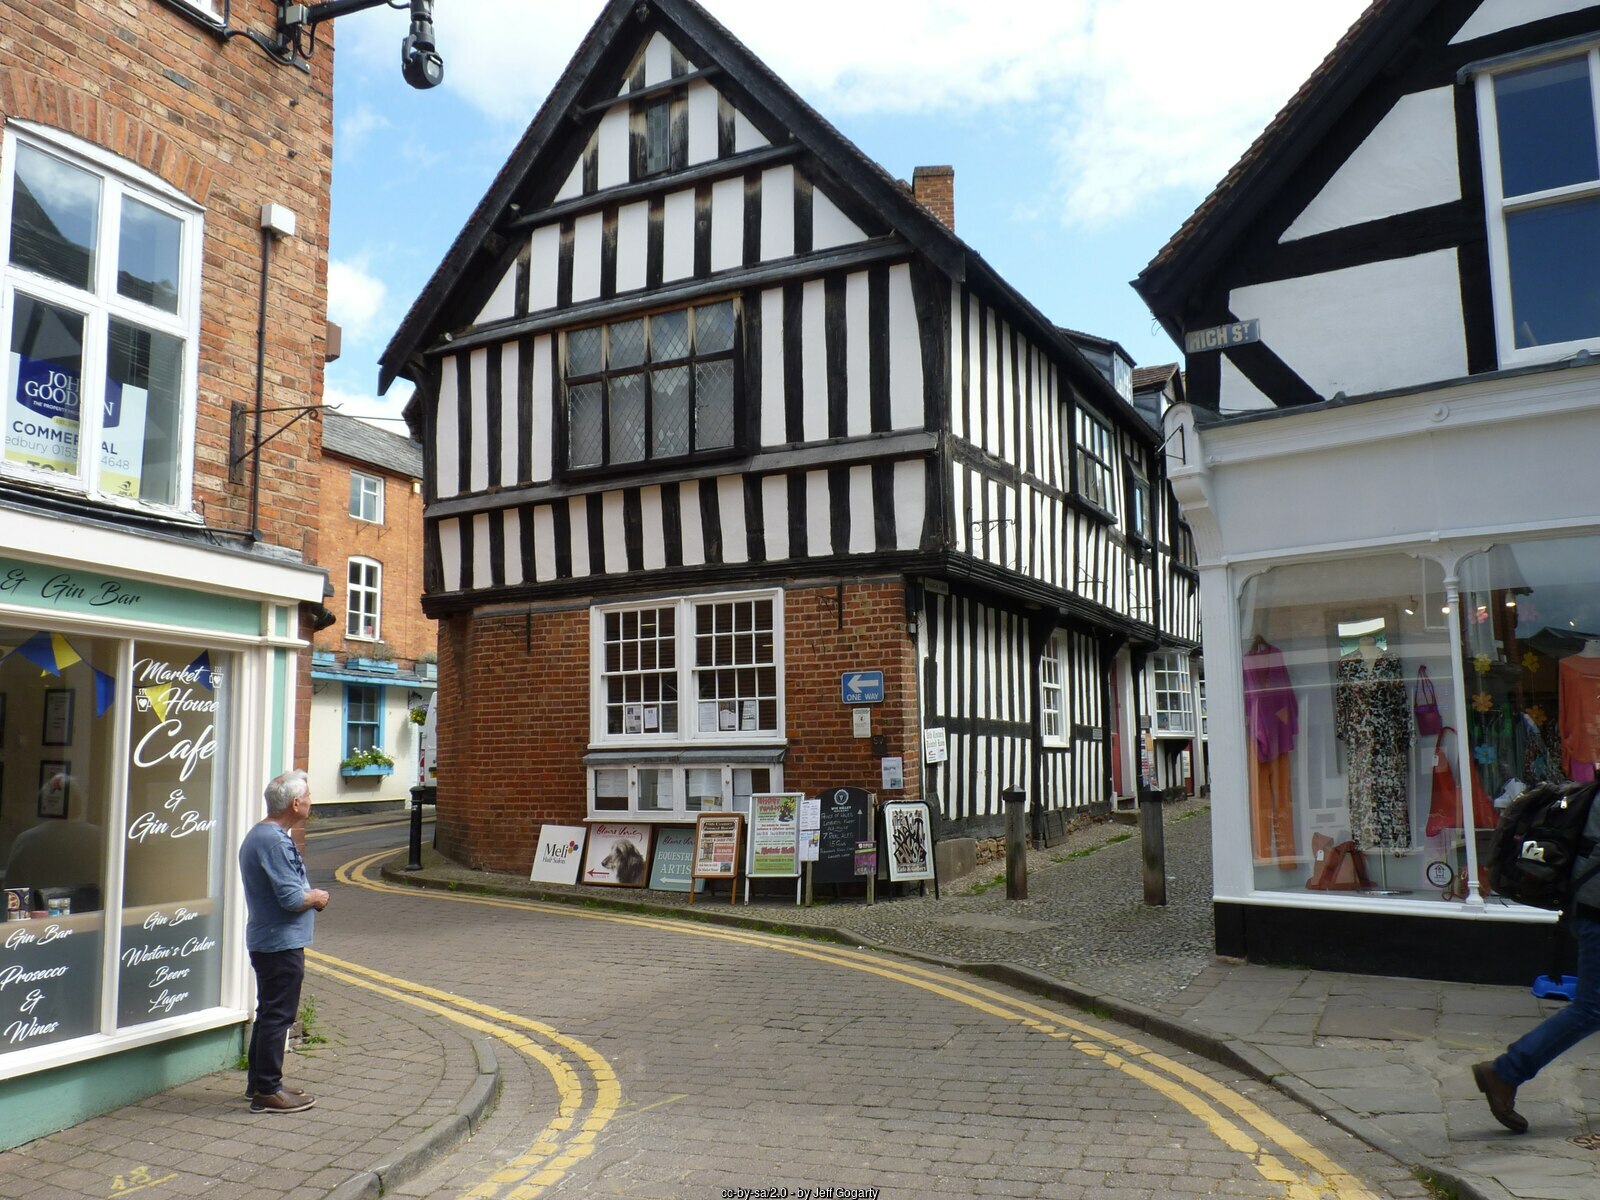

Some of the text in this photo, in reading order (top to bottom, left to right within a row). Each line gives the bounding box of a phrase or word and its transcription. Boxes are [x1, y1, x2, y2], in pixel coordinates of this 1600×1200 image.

[48, 370, 80, 393] JOH
[5, 435, 48, 455] edbury
[41, 573, 86, 604] Gin
[89, 580, 141, 606] Bar
[132, 658, 211, 684] Market
[158, 687, 219, 716] House
[846, 692, 879, 701] ONE WAY
[134, 718, 219, 782] Cafe
[128, 810, 217, 844] Gin Bar
[542, 856, 553, 864] Hair
[545, 843, 569, 859] Meli
[660, 864, 692, 875] ARTIS
[143, 908, 198, 930] Gin Bar
[5, 924, 74, 950] Gin Bar
[122, 937, 216, 968] Weston's Cider
[0, 965, 69, 991] Prosecco
[149, 966, 191, 988] Beers
[148, 989, 189, 1012] Lager
[4, 1017, 60, 1044] Wines
